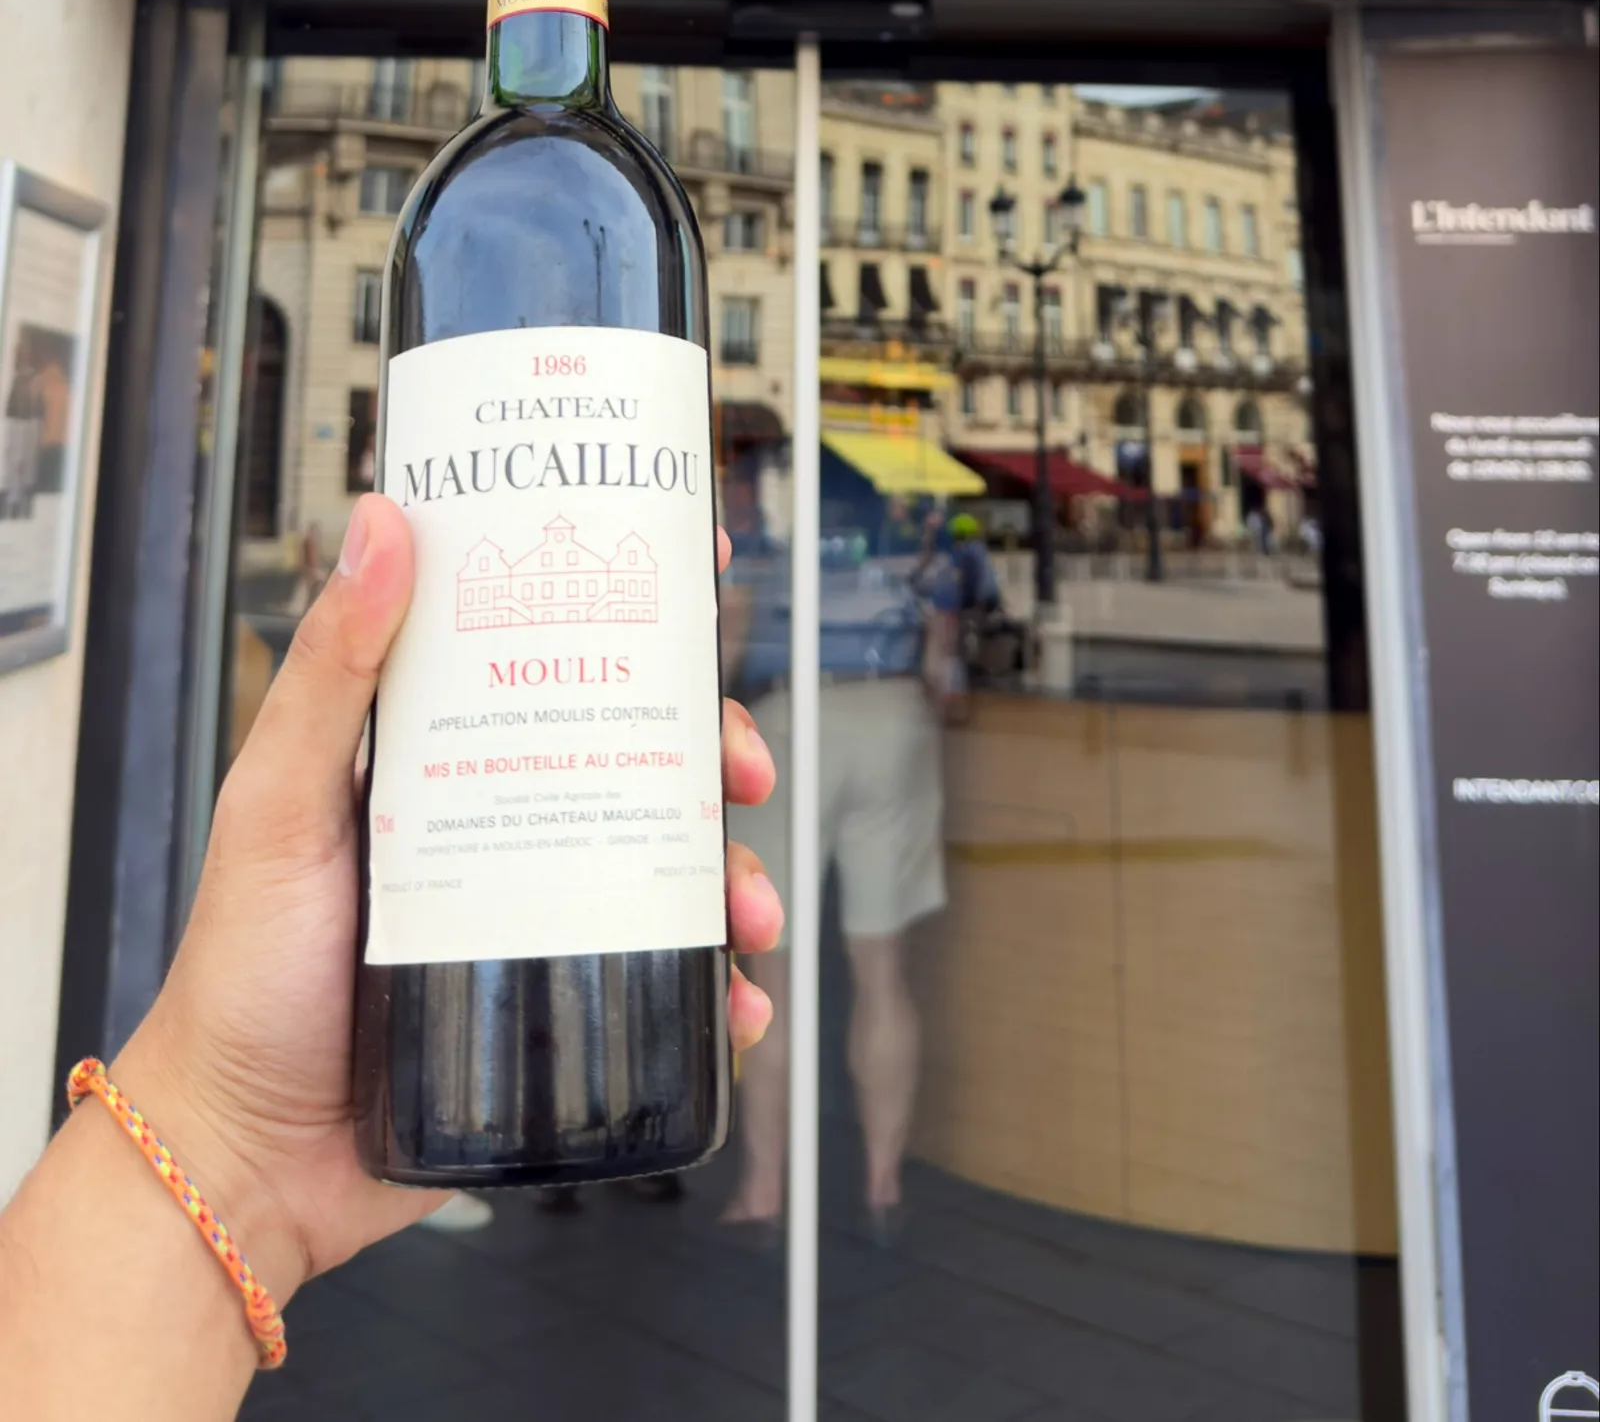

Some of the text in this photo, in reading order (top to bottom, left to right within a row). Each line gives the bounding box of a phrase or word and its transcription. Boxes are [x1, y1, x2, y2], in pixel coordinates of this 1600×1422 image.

[531, 354, 587, 376] 1986
[475, 396, 639, 424] CHATEAU
[402, 440, 698, 507] MAUCAILLOU
[488, 656, 632, 688] MOULIS
[429, 711, 528, 732] APPELLATION
[534, 708, 596, 725] MOULIS
[423, 751, 684, 779] MIS EN BOUTEILLE AU CHATEAU
[427, 815, 496, 833] DOMAINES
[501, 813, 522, 828] DU
[527, 810, 598, 826] CHATEAU
[602, 807, 682, 823] MAUCAILLOU
